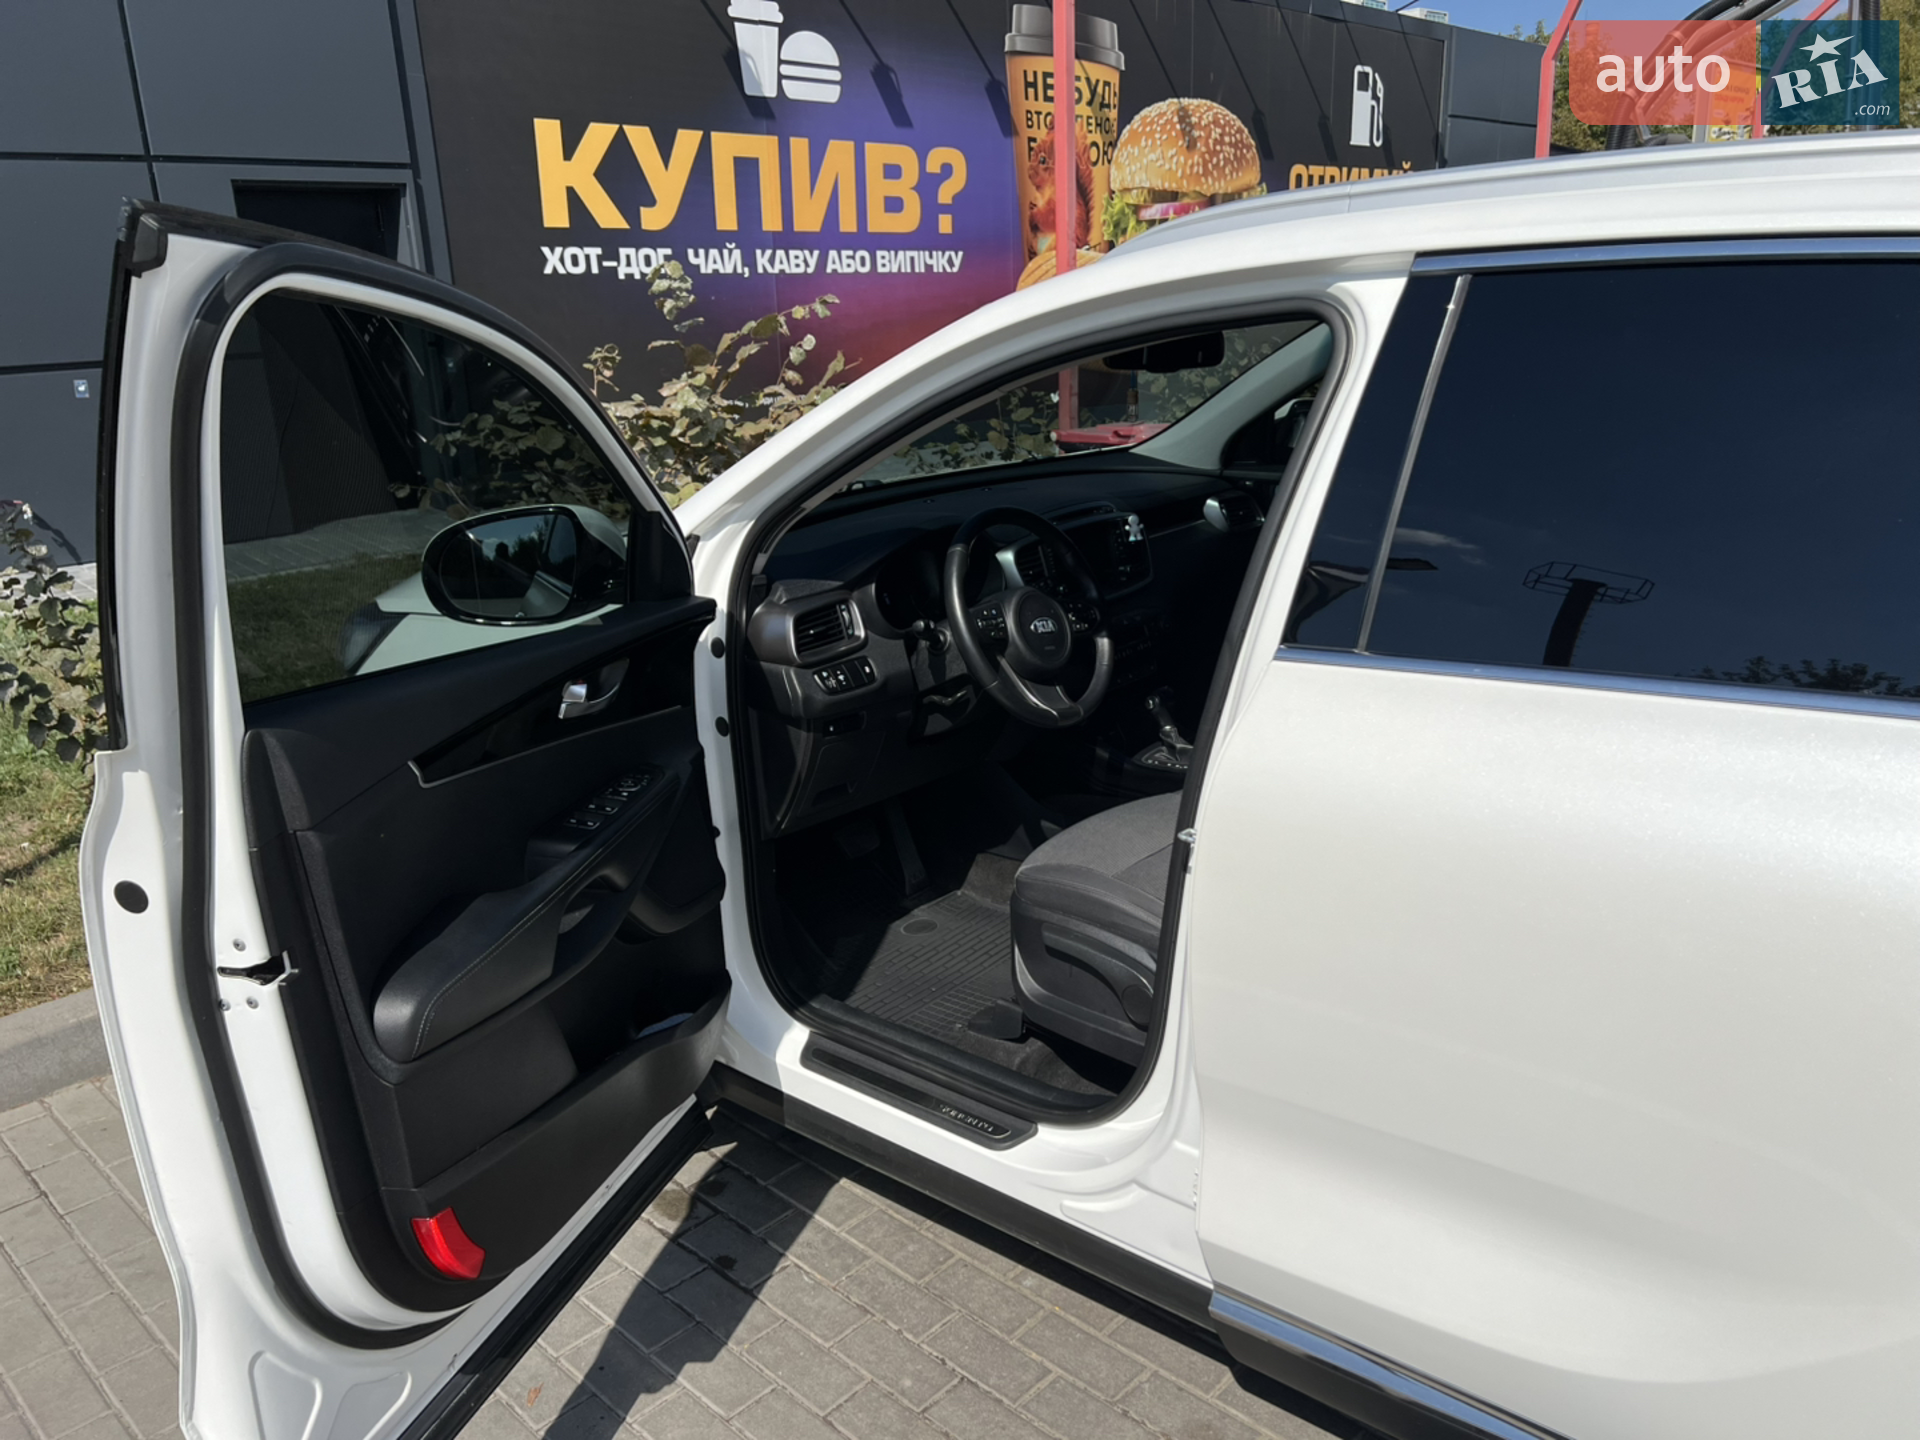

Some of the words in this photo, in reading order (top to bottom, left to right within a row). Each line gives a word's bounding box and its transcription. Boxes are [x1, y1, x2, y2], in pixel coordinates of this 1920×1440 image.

[533, 118, 968, 234] КУПИВ?
[687, 242, 749, 277] ЧАЙ,
[756, 249, 820, 274] КАВУ
[826, 250, 871, 273] АБО
[876, 250, 964, 273] ВИПІЧКУ
